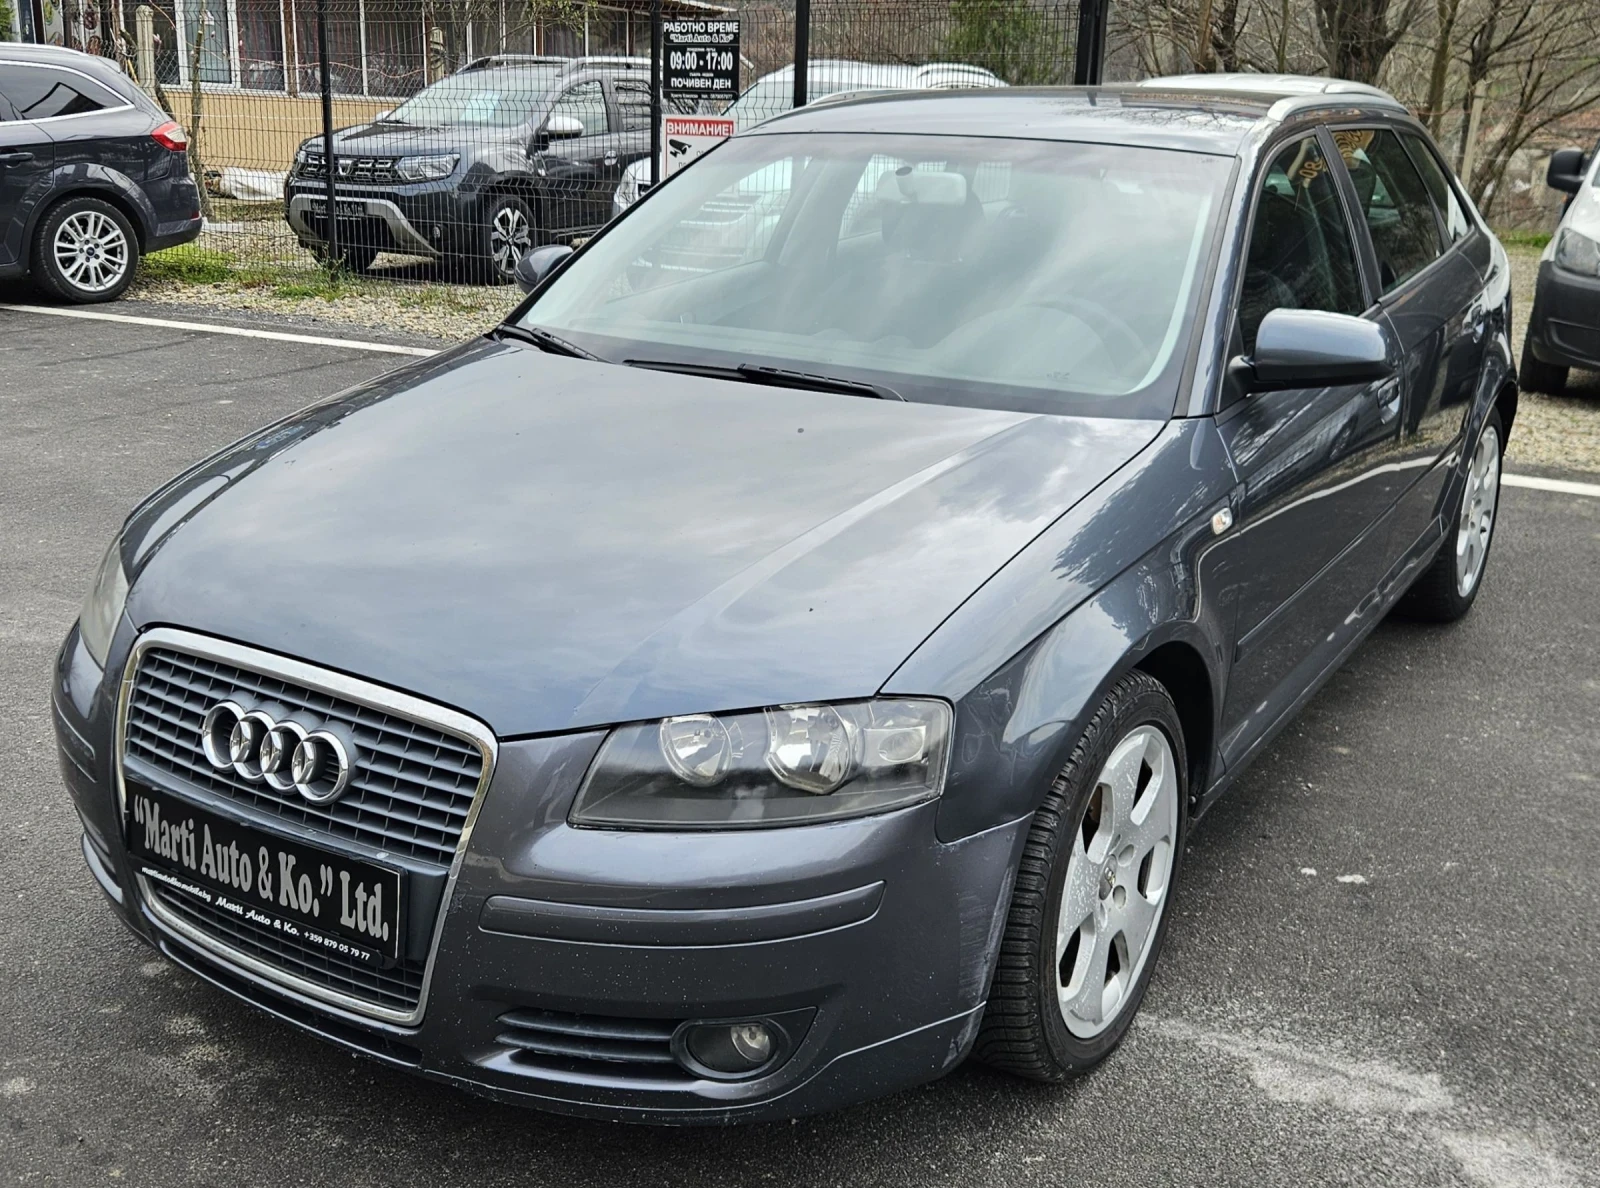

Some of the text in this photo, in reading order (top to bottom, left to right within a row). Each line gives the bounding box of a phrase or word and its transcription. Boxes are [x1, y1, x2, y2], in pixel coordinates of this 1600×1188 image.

[663, 22, 739, 33] РАБОТНО ВРЕМЕ
[693, 33, 712, 43] Auto
[711, 33, 719, 43] &
[670, 51, 698, 70] 09:00
[706, 51, 733, 71] 17:00
[670, 78, 732, 90] ПОЧИВЕН ДЕН
[666, 121, 734, 136] ВНИМАНИЕ!
[200, 823, 252, 893] Auto
[257, 846, 273, 902] &
[339, 870, 389, 942] Ltd.
[215, 895, 244, 915] Marti
[245, 909, 271, 926] Auto
[273, 919, 282, 930] &
[283, 921, 300, 937] Ko.
[303, 931, 323, 944] +359
[323, 938, 338, 949] 879
[338, 943, 349, 953] 05
[350, 947, 360, 957] 79
[361, 951, 371, 961] 77
